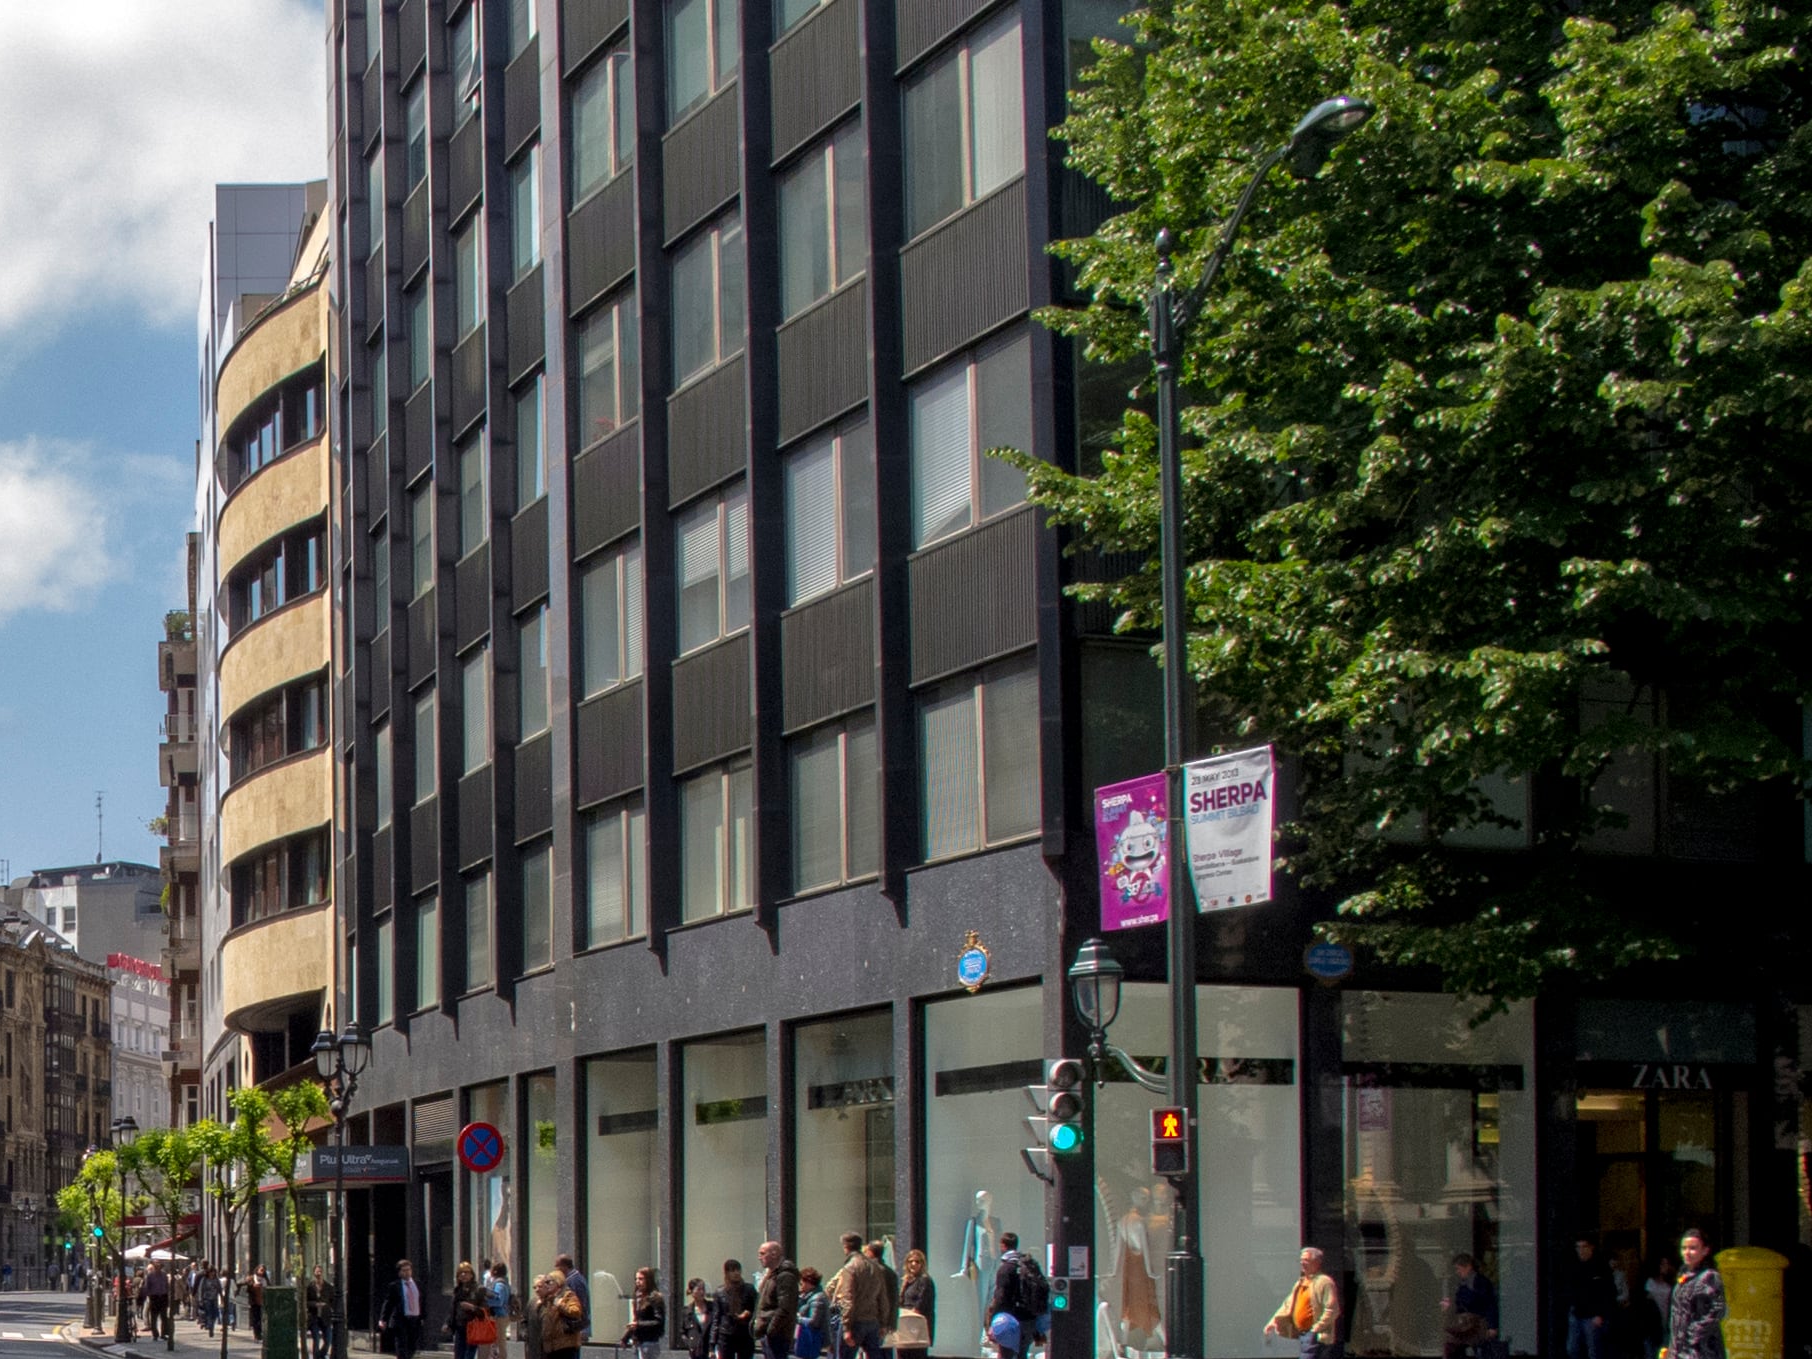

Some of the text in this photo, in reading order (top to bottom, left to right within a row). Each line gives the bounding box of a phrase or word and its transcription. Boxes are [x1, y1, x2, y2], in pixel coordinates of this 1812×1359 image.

[1101, 793, 1133, 809] SHERPA
[1190, 780, 1267, 813] SHERPA
[1190, 810, 1225, 825] SUMMIT
[1632, 1064, 1713, 1089] ZARA
